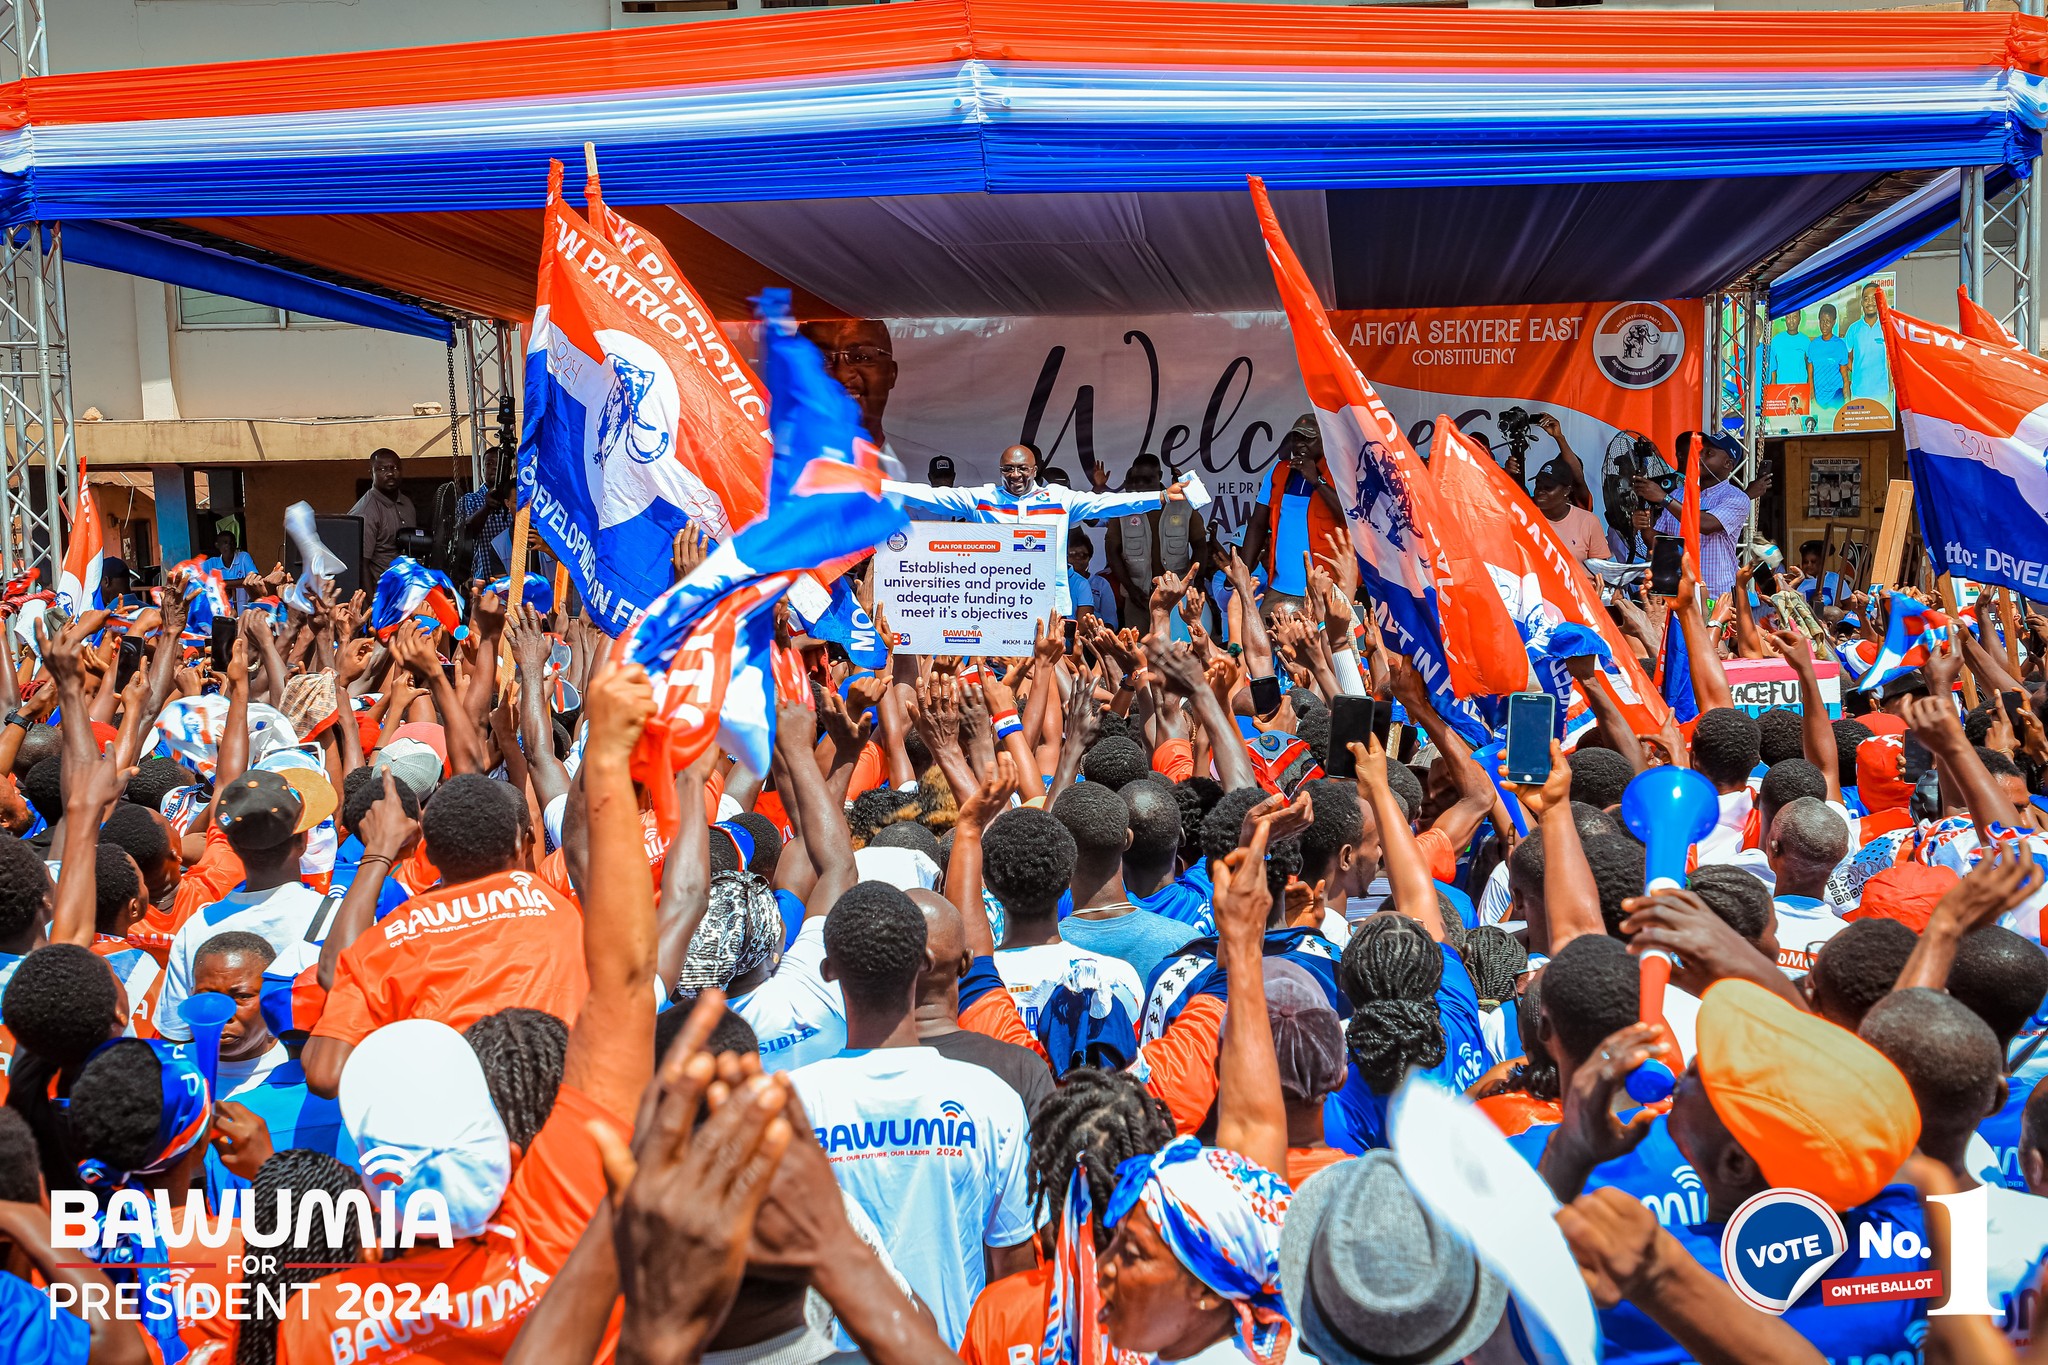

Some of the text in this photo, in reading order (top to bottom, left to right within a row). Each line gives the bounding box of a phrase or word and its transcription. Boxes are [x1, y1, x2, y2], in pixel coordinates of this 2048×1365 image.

[1349, 316, 1583, 346] AFIGYA SEKYERE EAST
[1412, 348, 1516, 366] CONSTITUENCY
[1019, 330, 1492, 493] Welce
[1218, 482, 1254, 494] H.E DR
[900, 560, 1031, 578] Established opened
[884, 576, 1046, 592] universities and provide
[896, 591, 1033, 607] adequate funding to
[901, 605, 1028, 621] meet it's objectives
[943, 629, 983, 637] BAWUMIA
[384, 885, 556, 941] BAWUMIA
[488, 911, 516, 921] LEADER
[518, 908, 547, 917] 2024
[828, 1156, 845, 1164] OPE,
[861, 1151, 890, 1160] FUTURE,
[936, 1148, 963, 1157] 2024
